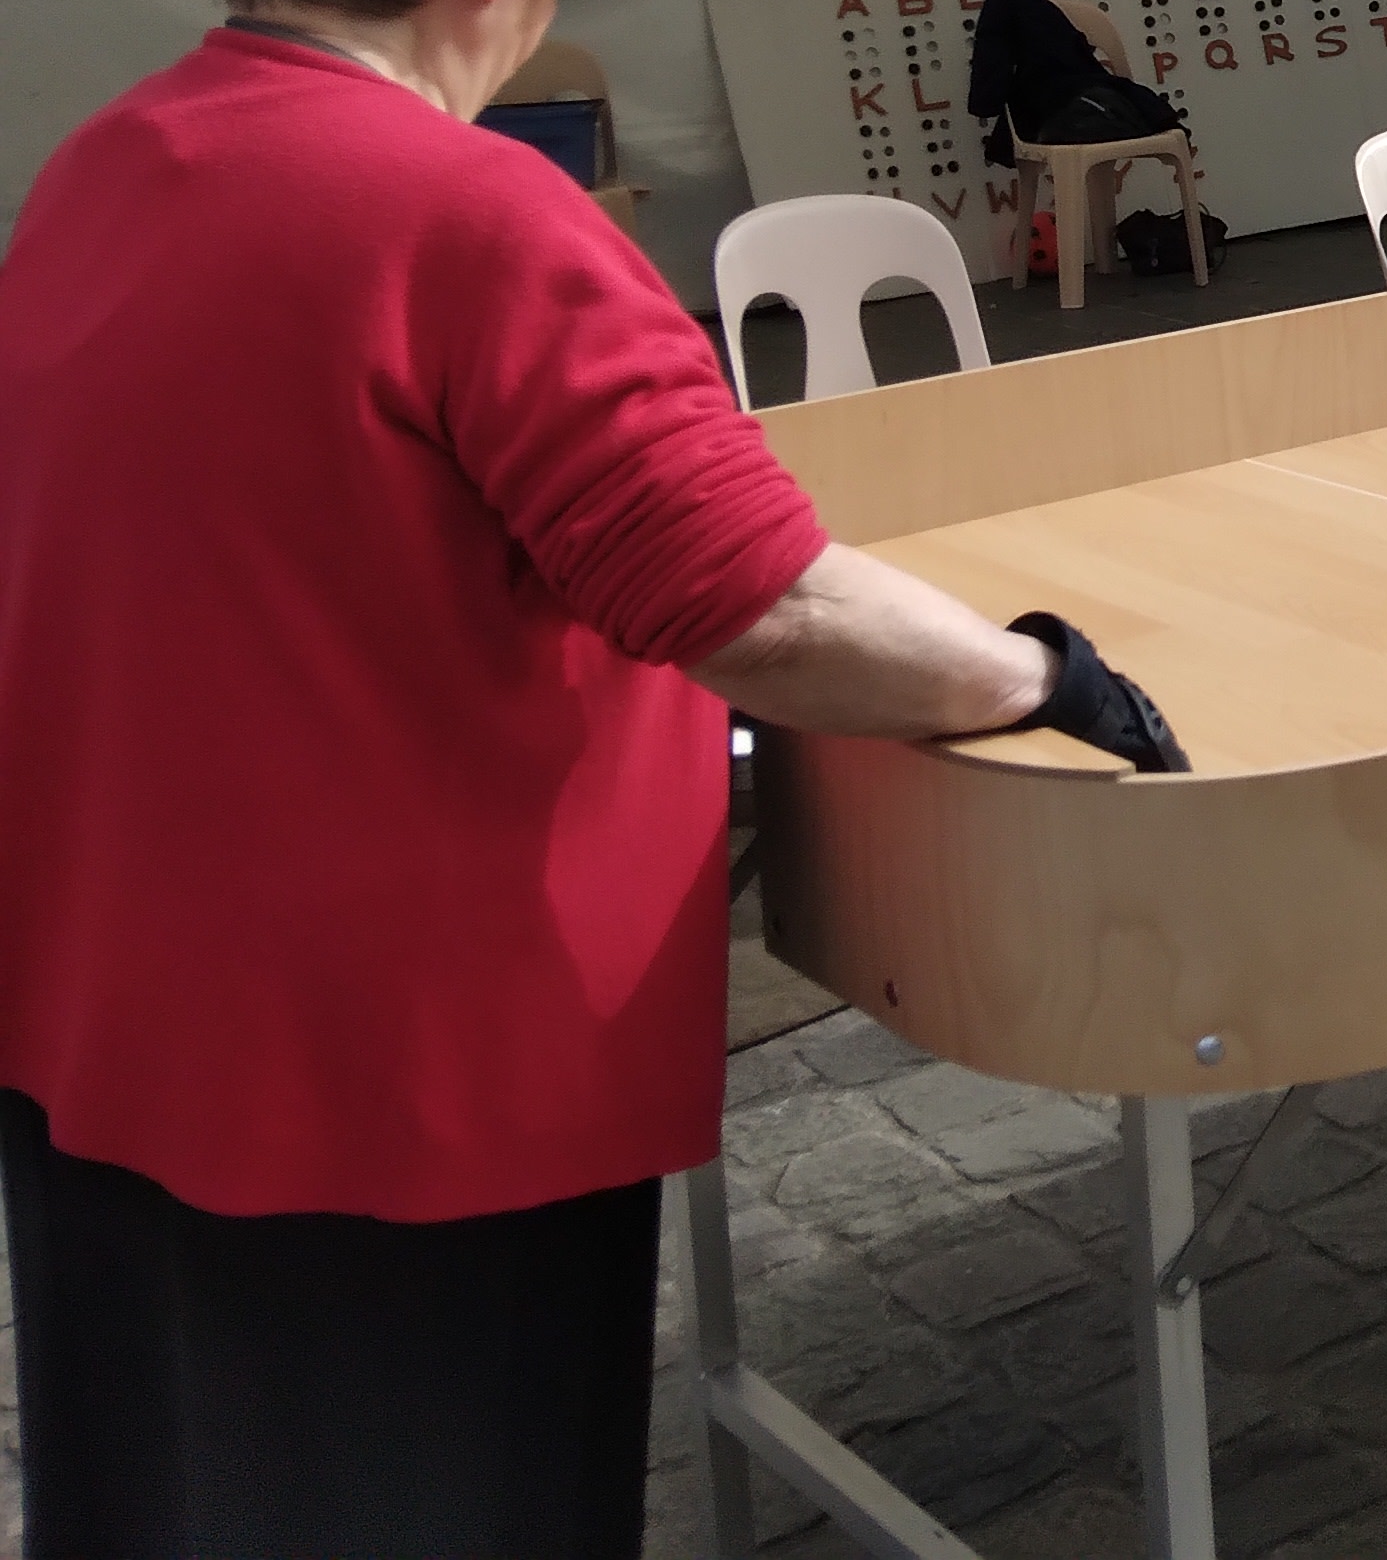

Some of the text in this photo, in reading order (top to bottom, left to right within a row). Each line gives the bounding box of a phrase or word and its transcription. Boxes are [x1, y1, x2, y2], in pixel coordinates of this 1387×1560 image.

[1152, 52, 1179, 85] P
[1204, 39, 1239, 71] Q
[1261, 32, 1295, 66] R
[1315, 25, 1348, 59] S
[851, 78, 951, 120] K L
[931, 188, 967, 221] V
